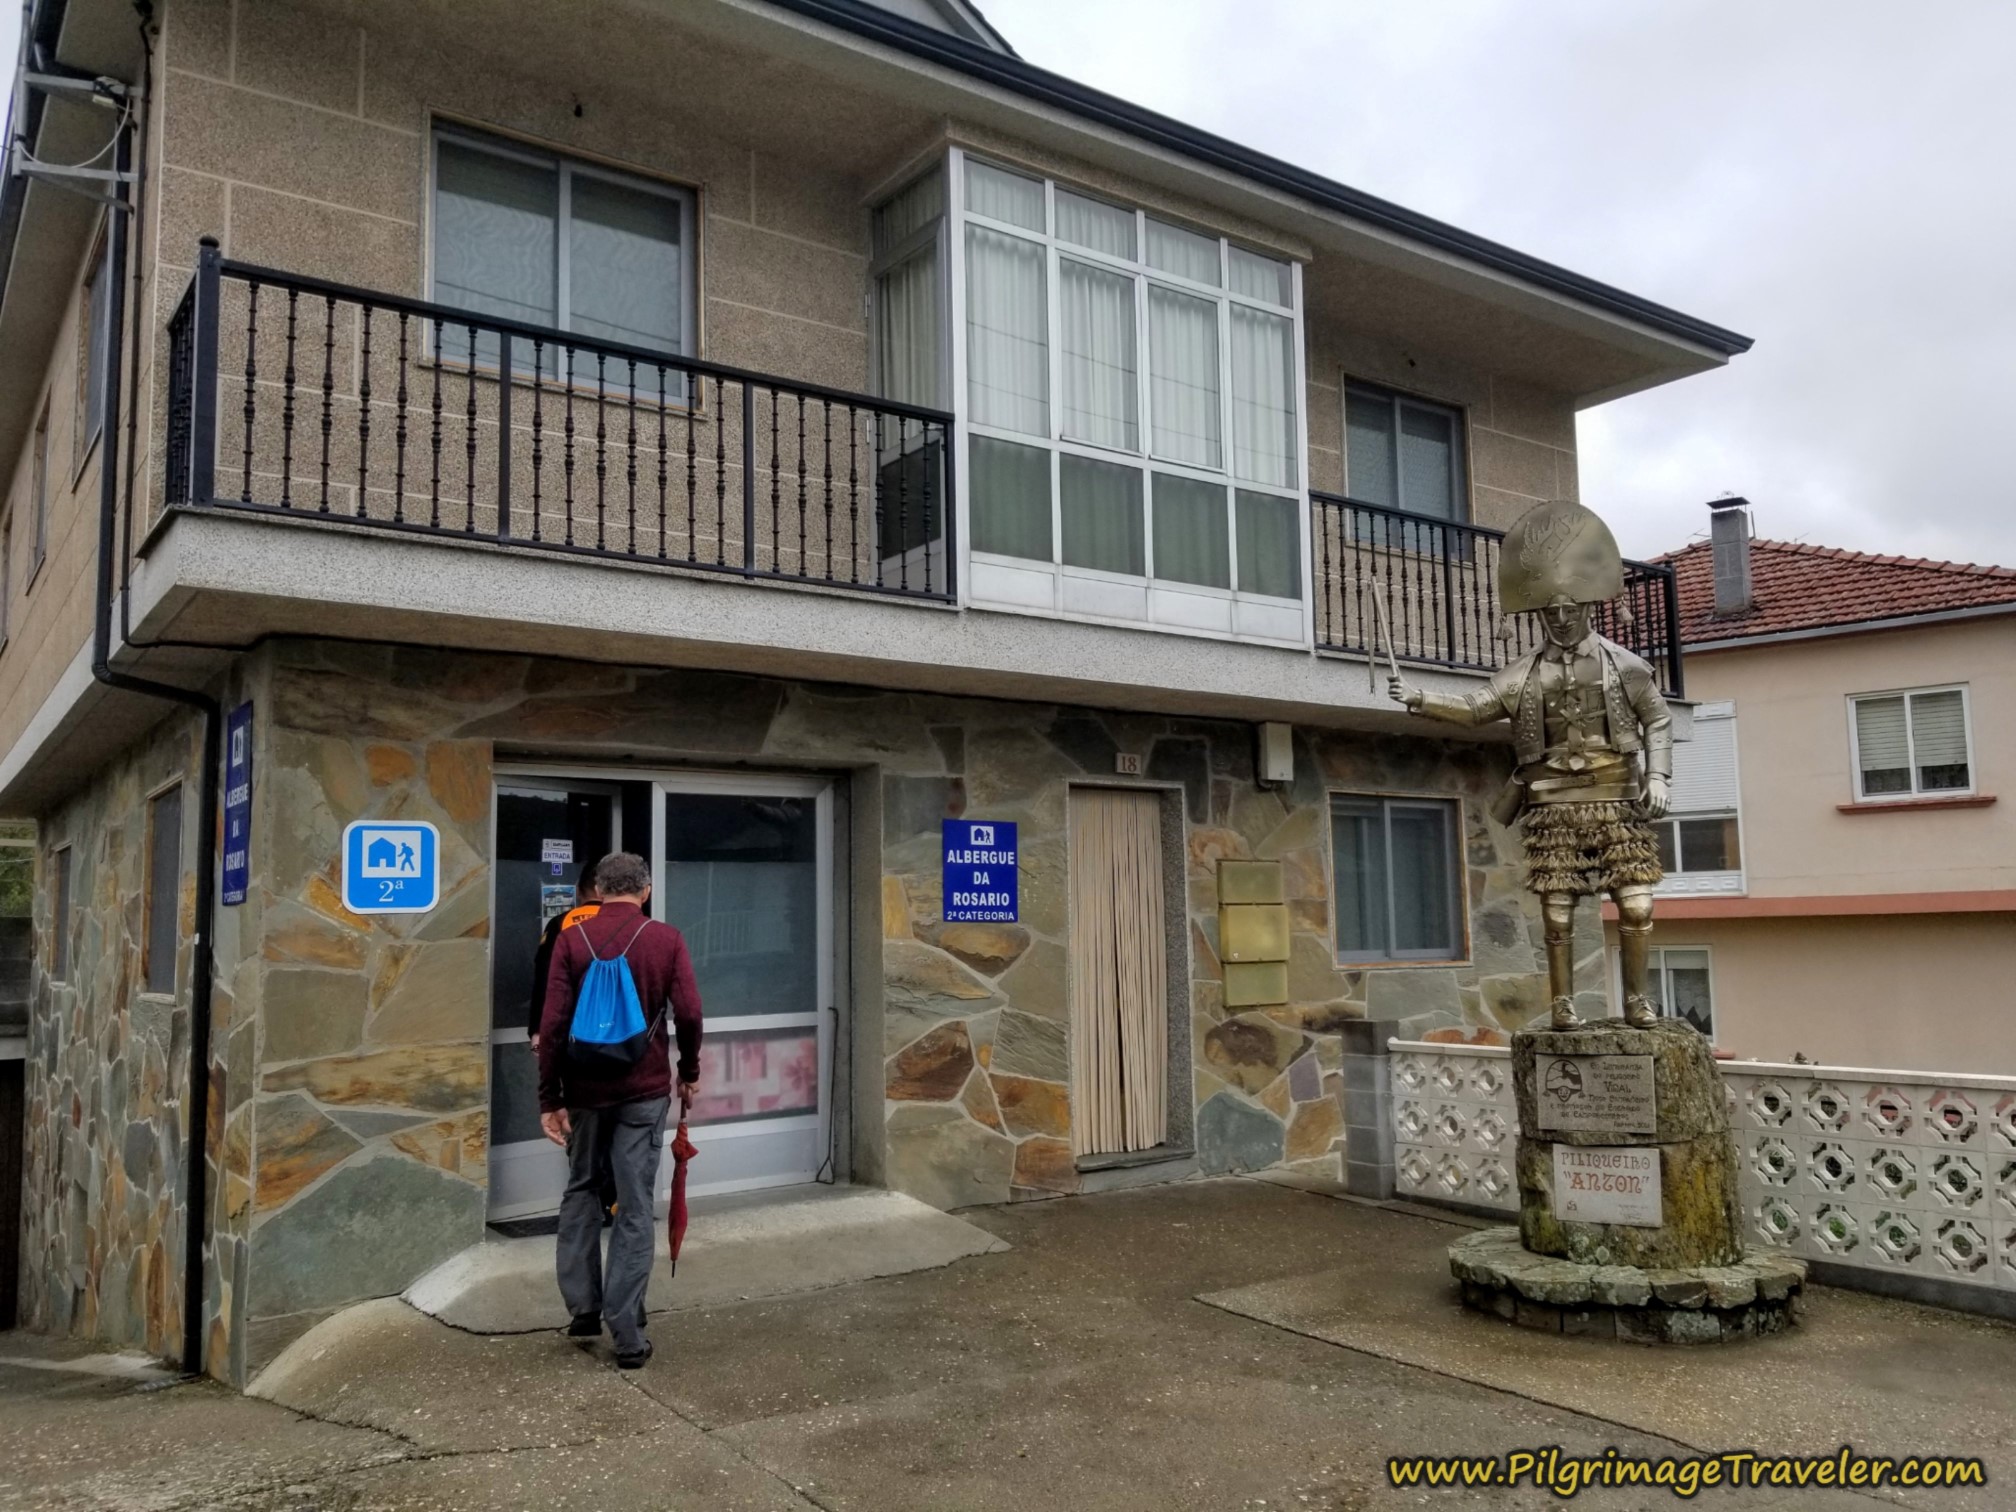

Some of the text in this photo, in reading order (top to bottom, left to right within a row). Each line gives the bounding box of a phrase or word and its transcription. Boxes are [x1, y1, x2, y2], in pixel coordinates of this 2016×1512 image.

[1121, 755, 1137, 772] 18
[544, 851, 571, 860] ENTRADA
[946, 849, 1015, 865] ALBERGUE
[973, 871, 990, 885] DA
[953, 892, 1010, 907] ROSARIO
[958, 911, 1015, 921] CATEGORIA
[1561, 1152, 1651, 1170] PILIQUEIRO
